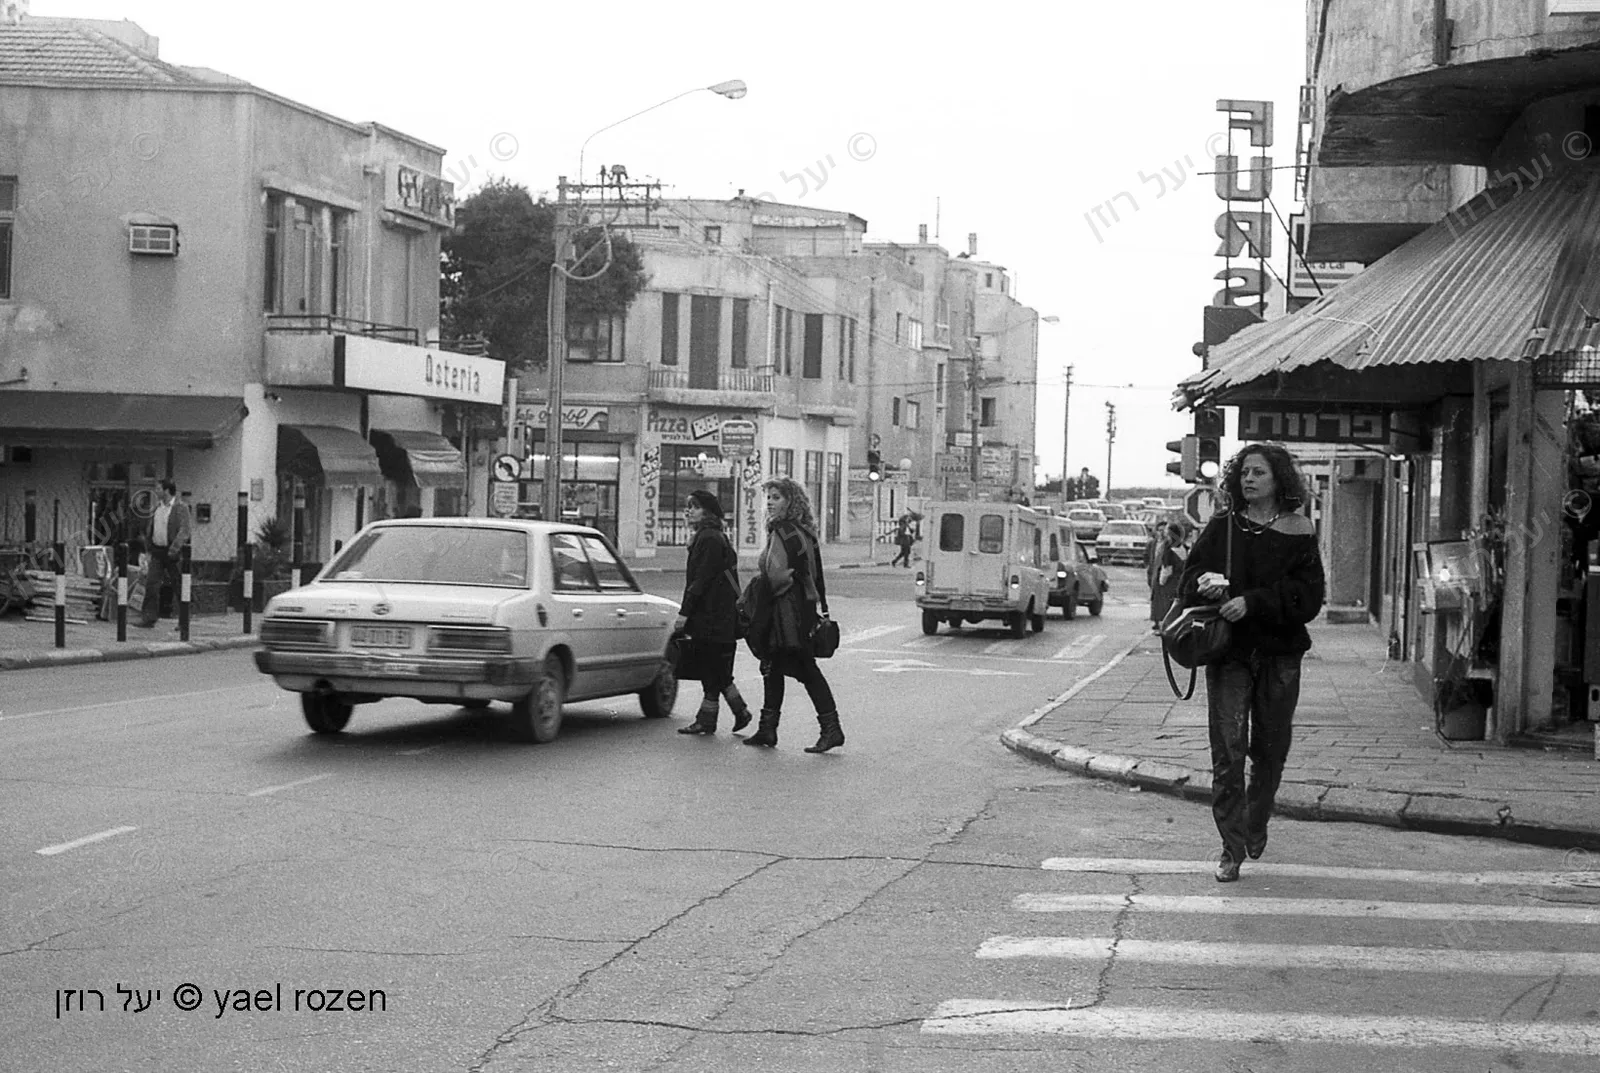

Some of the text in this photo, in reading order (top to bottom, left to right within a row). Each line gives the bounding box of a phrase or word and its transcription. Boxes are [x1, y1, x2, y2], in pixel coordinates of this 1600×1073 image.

[426, 354, 480, 393] Osteria
[647, 410, 688, 433] Pizza
[1245, 411, 1383, 438] פרוות
